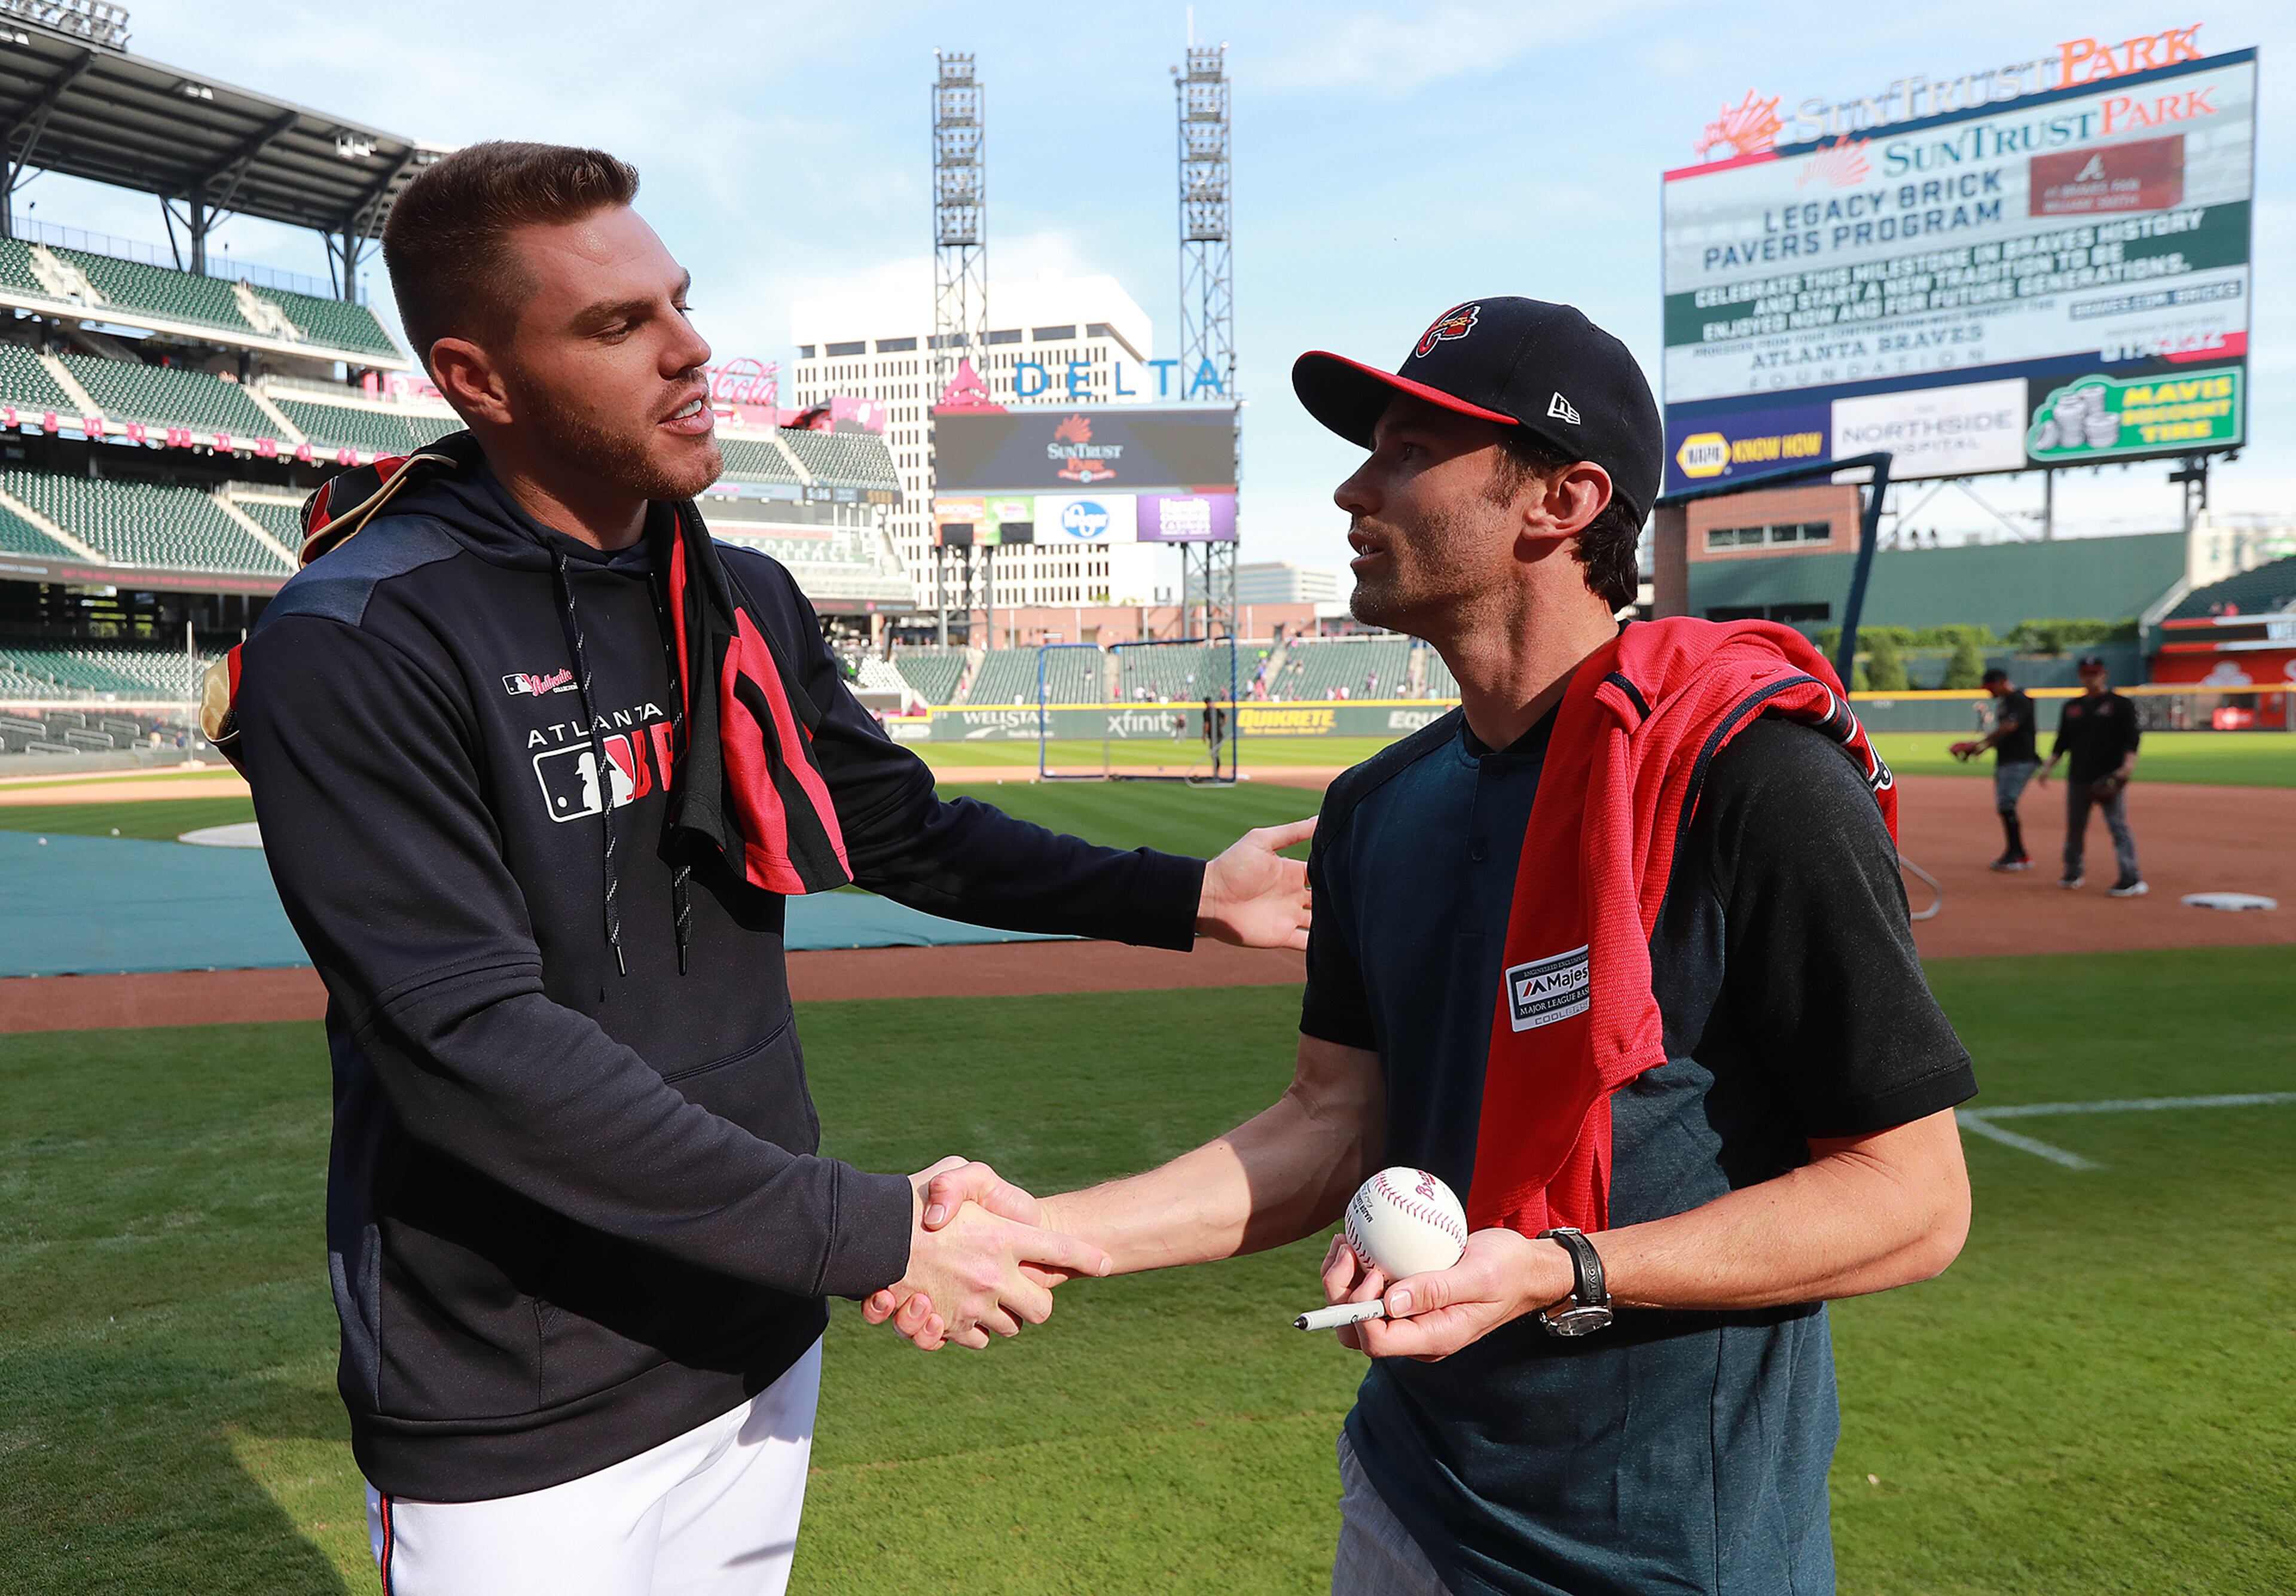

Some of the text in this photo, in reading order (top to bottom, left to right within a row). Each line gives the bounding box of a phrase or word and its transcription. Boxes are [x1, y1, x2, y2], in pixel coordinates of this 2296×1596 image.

[1764, 169, 2002, 234] LEGACY BRICK
[1703, 200, 2002, 271] PAVERS PROGRAM
[1695, 209, 2205, 309] CELEBRATE THIS MILESTONE IN BRAVES HISTORY
[1752, 242, 2124, 317] AND START A NEW TRADITION TO BE
[1703, 313, 1788, 342] ENJOYED
[1789, 306, 1837, 329] NOW
[1838, 301, 1883, 323] AND
[1884, 292, 1928, 315] FOR
[1929, 279, 2017, 309] FUTURE
[1750, 324, 1983, 370] ATLANTA BRAVES
[1015, 359, 1224, 396] DELTA
[2122, 376, 2232, 408] MAVIS
[1842, 409, 2013, 444] NORTHSIDE
[2138, 419, 2212, 443] TIRE
[1733, 437, 1781, 463] KNOW
[1782, 432, 1822, 457] HOW
[1519, 1002, 1546, 1016] MAJOR
[1547, 991, 1577, 1009] LEAGUE
